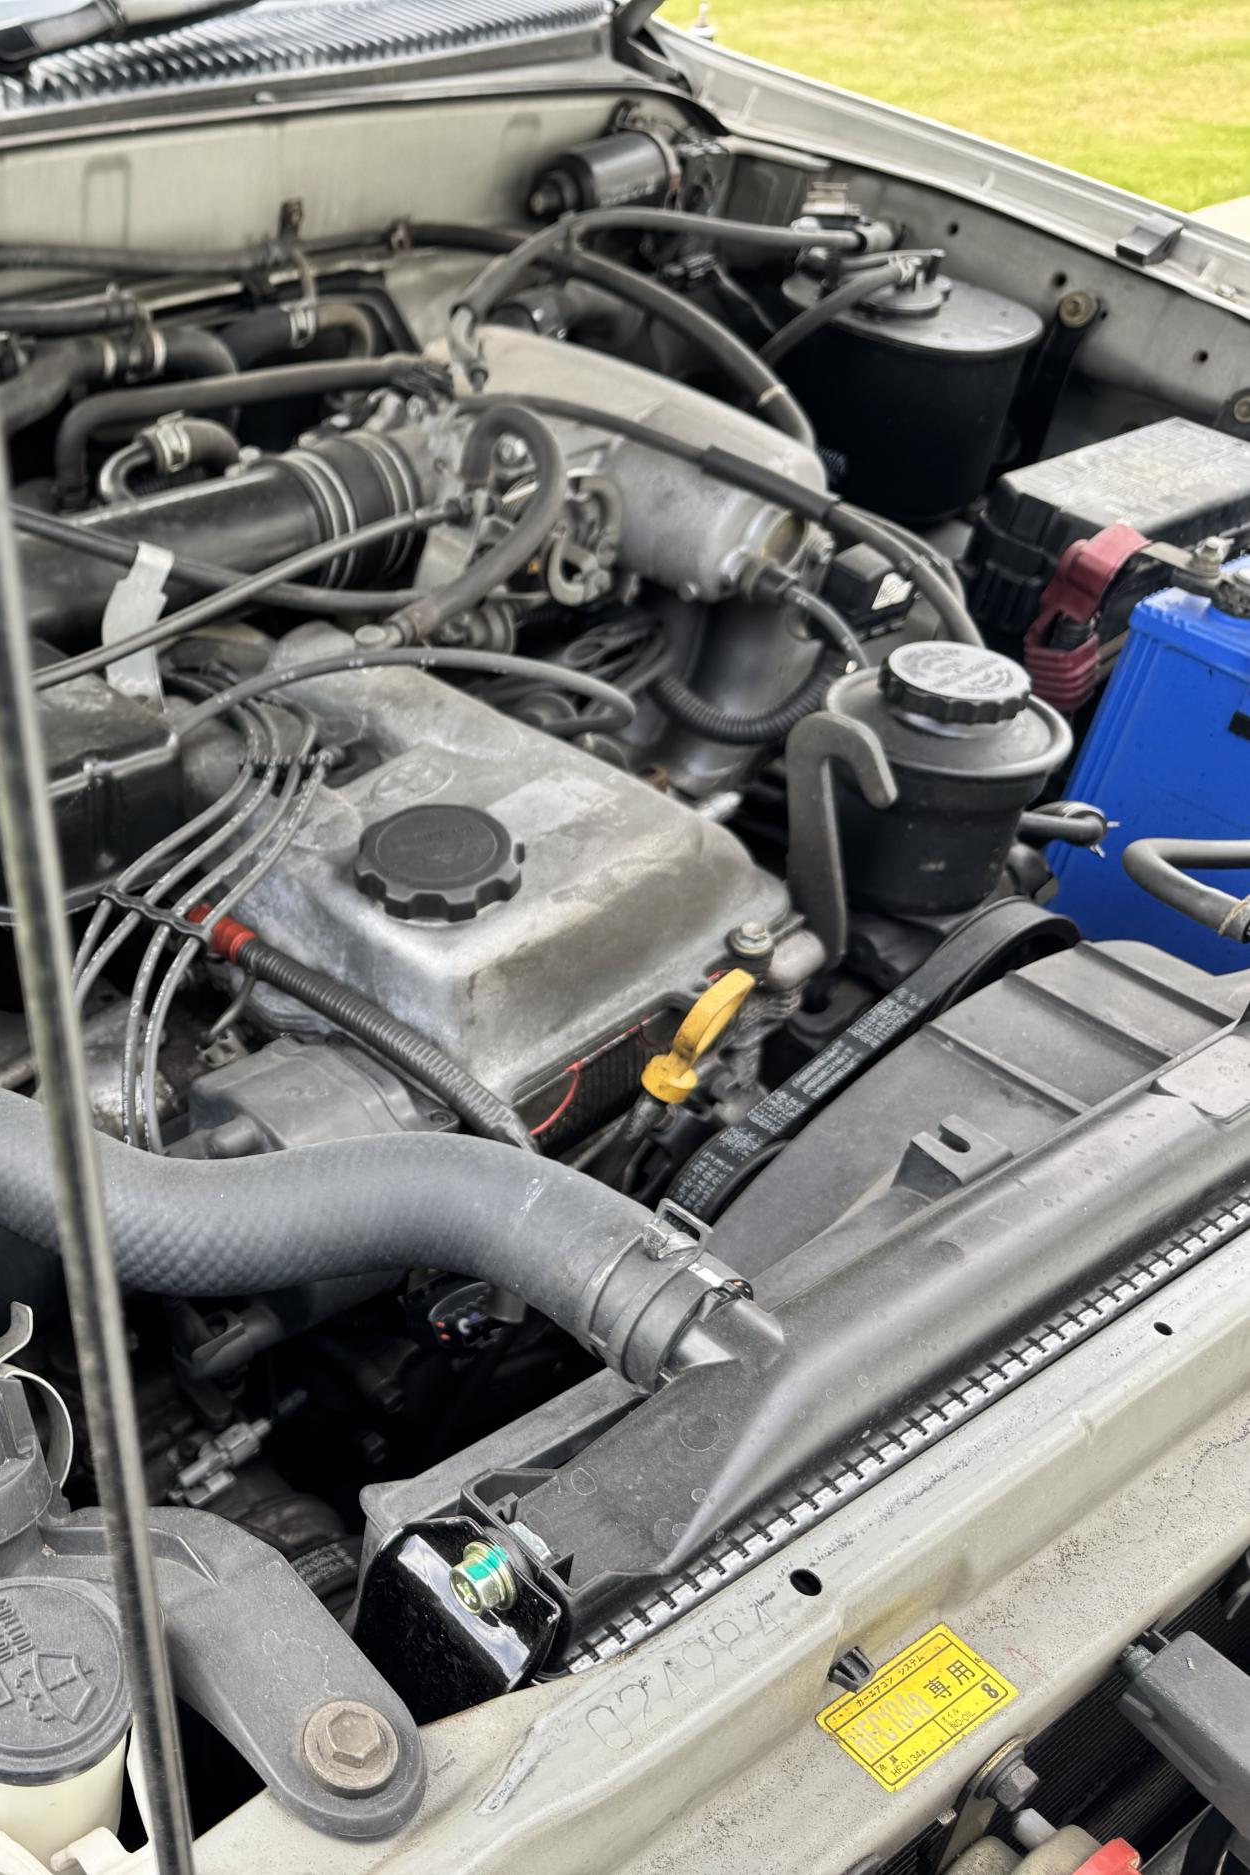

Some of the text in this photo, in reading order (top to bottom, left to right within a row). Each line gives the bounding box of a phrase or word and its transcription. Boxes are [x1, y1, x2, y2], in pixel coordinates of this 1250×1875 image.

[855, 1655, 926, 1708] カーエアコン システム
[980, 1682, 1000, 1699] 8
[844, 1658, 976, 1760] HFC134a 専用
[890, 1748, 927, 1778] HFC134a
